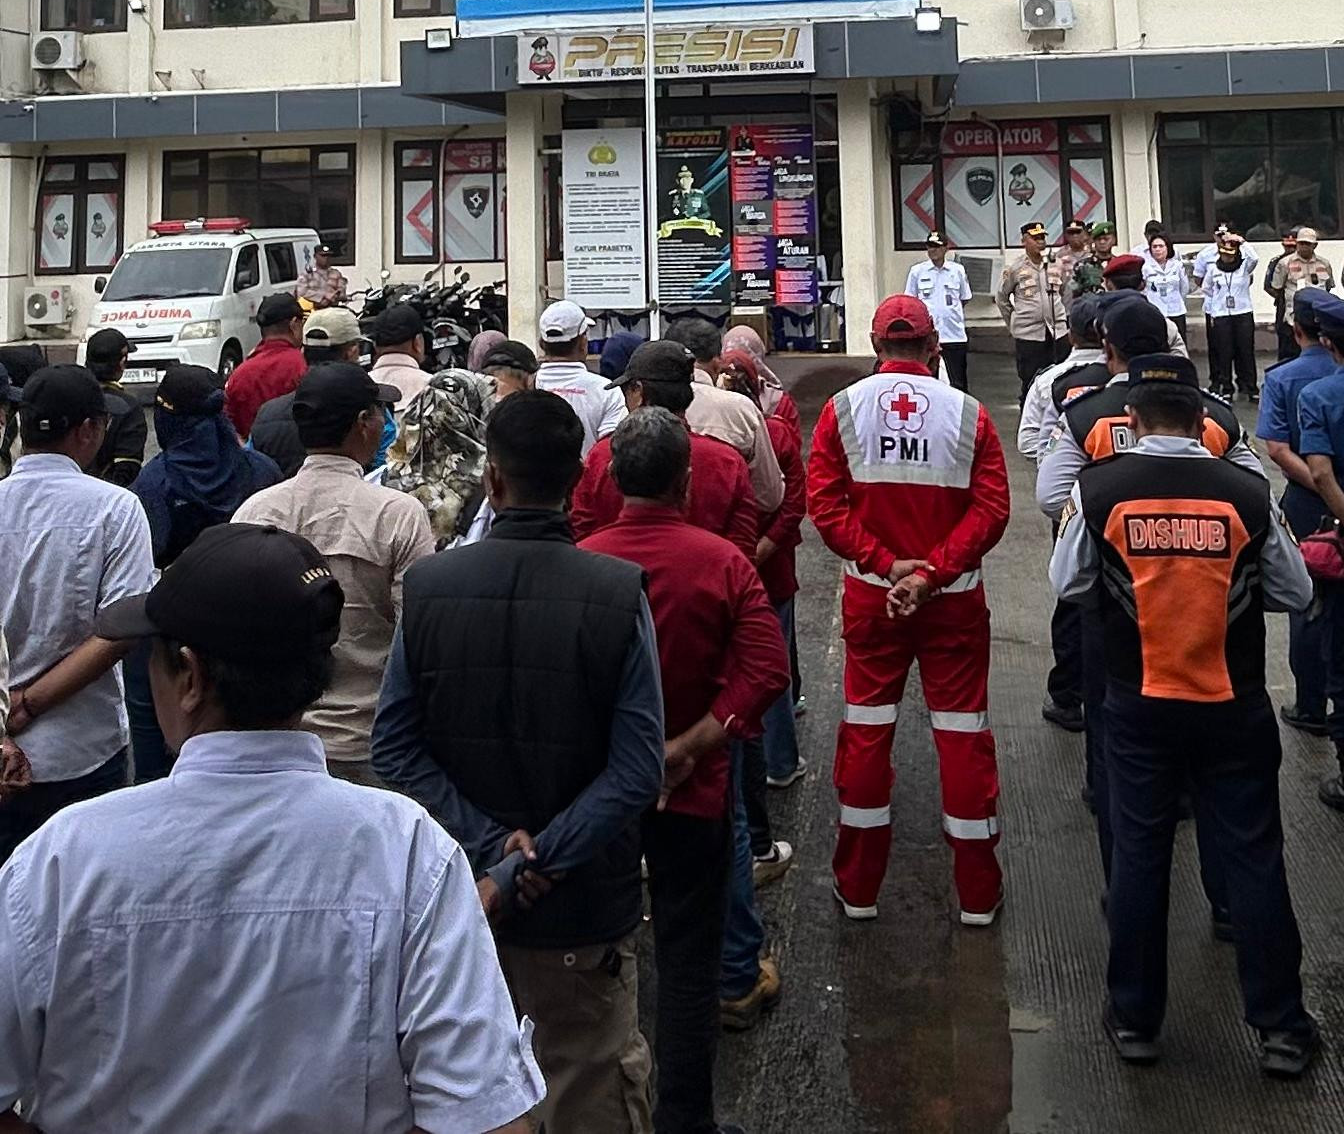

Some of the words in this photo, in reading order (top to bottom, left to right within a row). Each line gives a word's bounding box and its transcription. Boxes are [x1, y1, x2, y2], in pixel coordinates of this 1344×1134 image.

[564, 27, 801, 68] PRESISI
[954, 128, 1043, 146] OPERATOR
[880, 436, 928, 463] PMI
[1128, 517, 1228, 553] DISHUB
